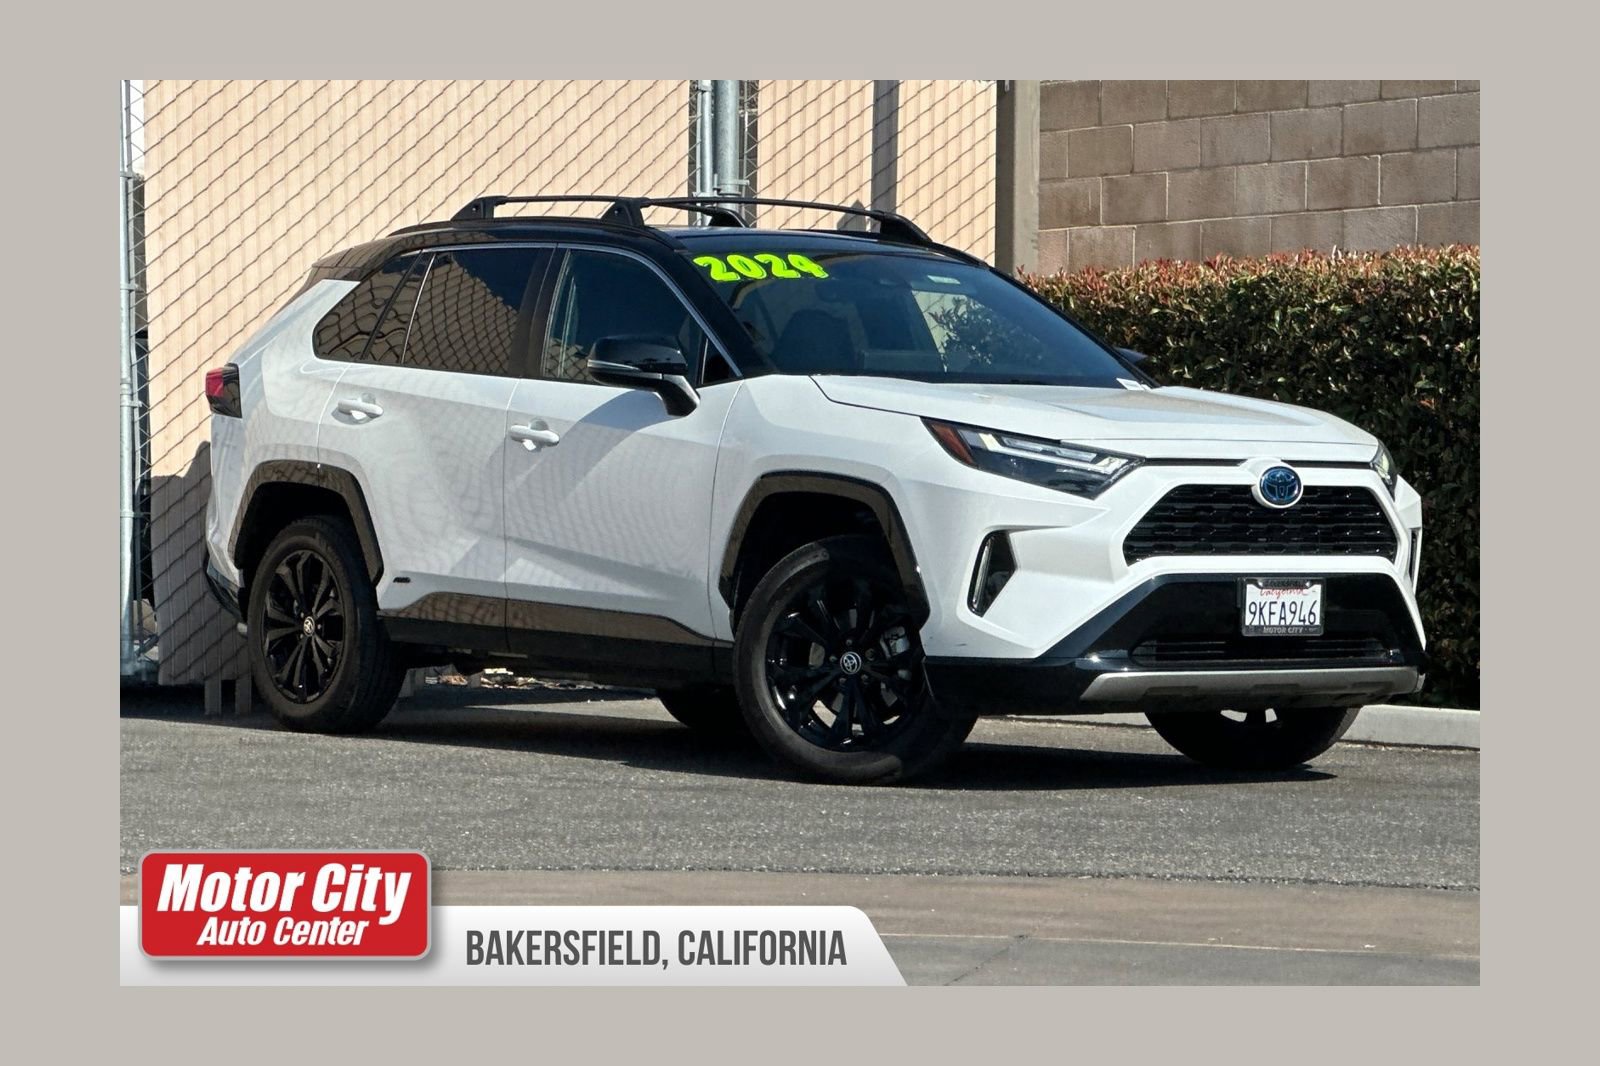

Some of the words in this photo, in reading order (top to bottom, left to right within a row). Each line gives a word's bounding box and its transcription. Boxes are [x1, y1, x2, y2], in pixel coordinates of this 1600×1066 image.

[692, 253, 829, 282] 2024
[1248, 600, 1318, 626] 9KFA946
[1263, 626, 1287, 634] MOTOR
[1288, 626, 1304, 634] CITY
